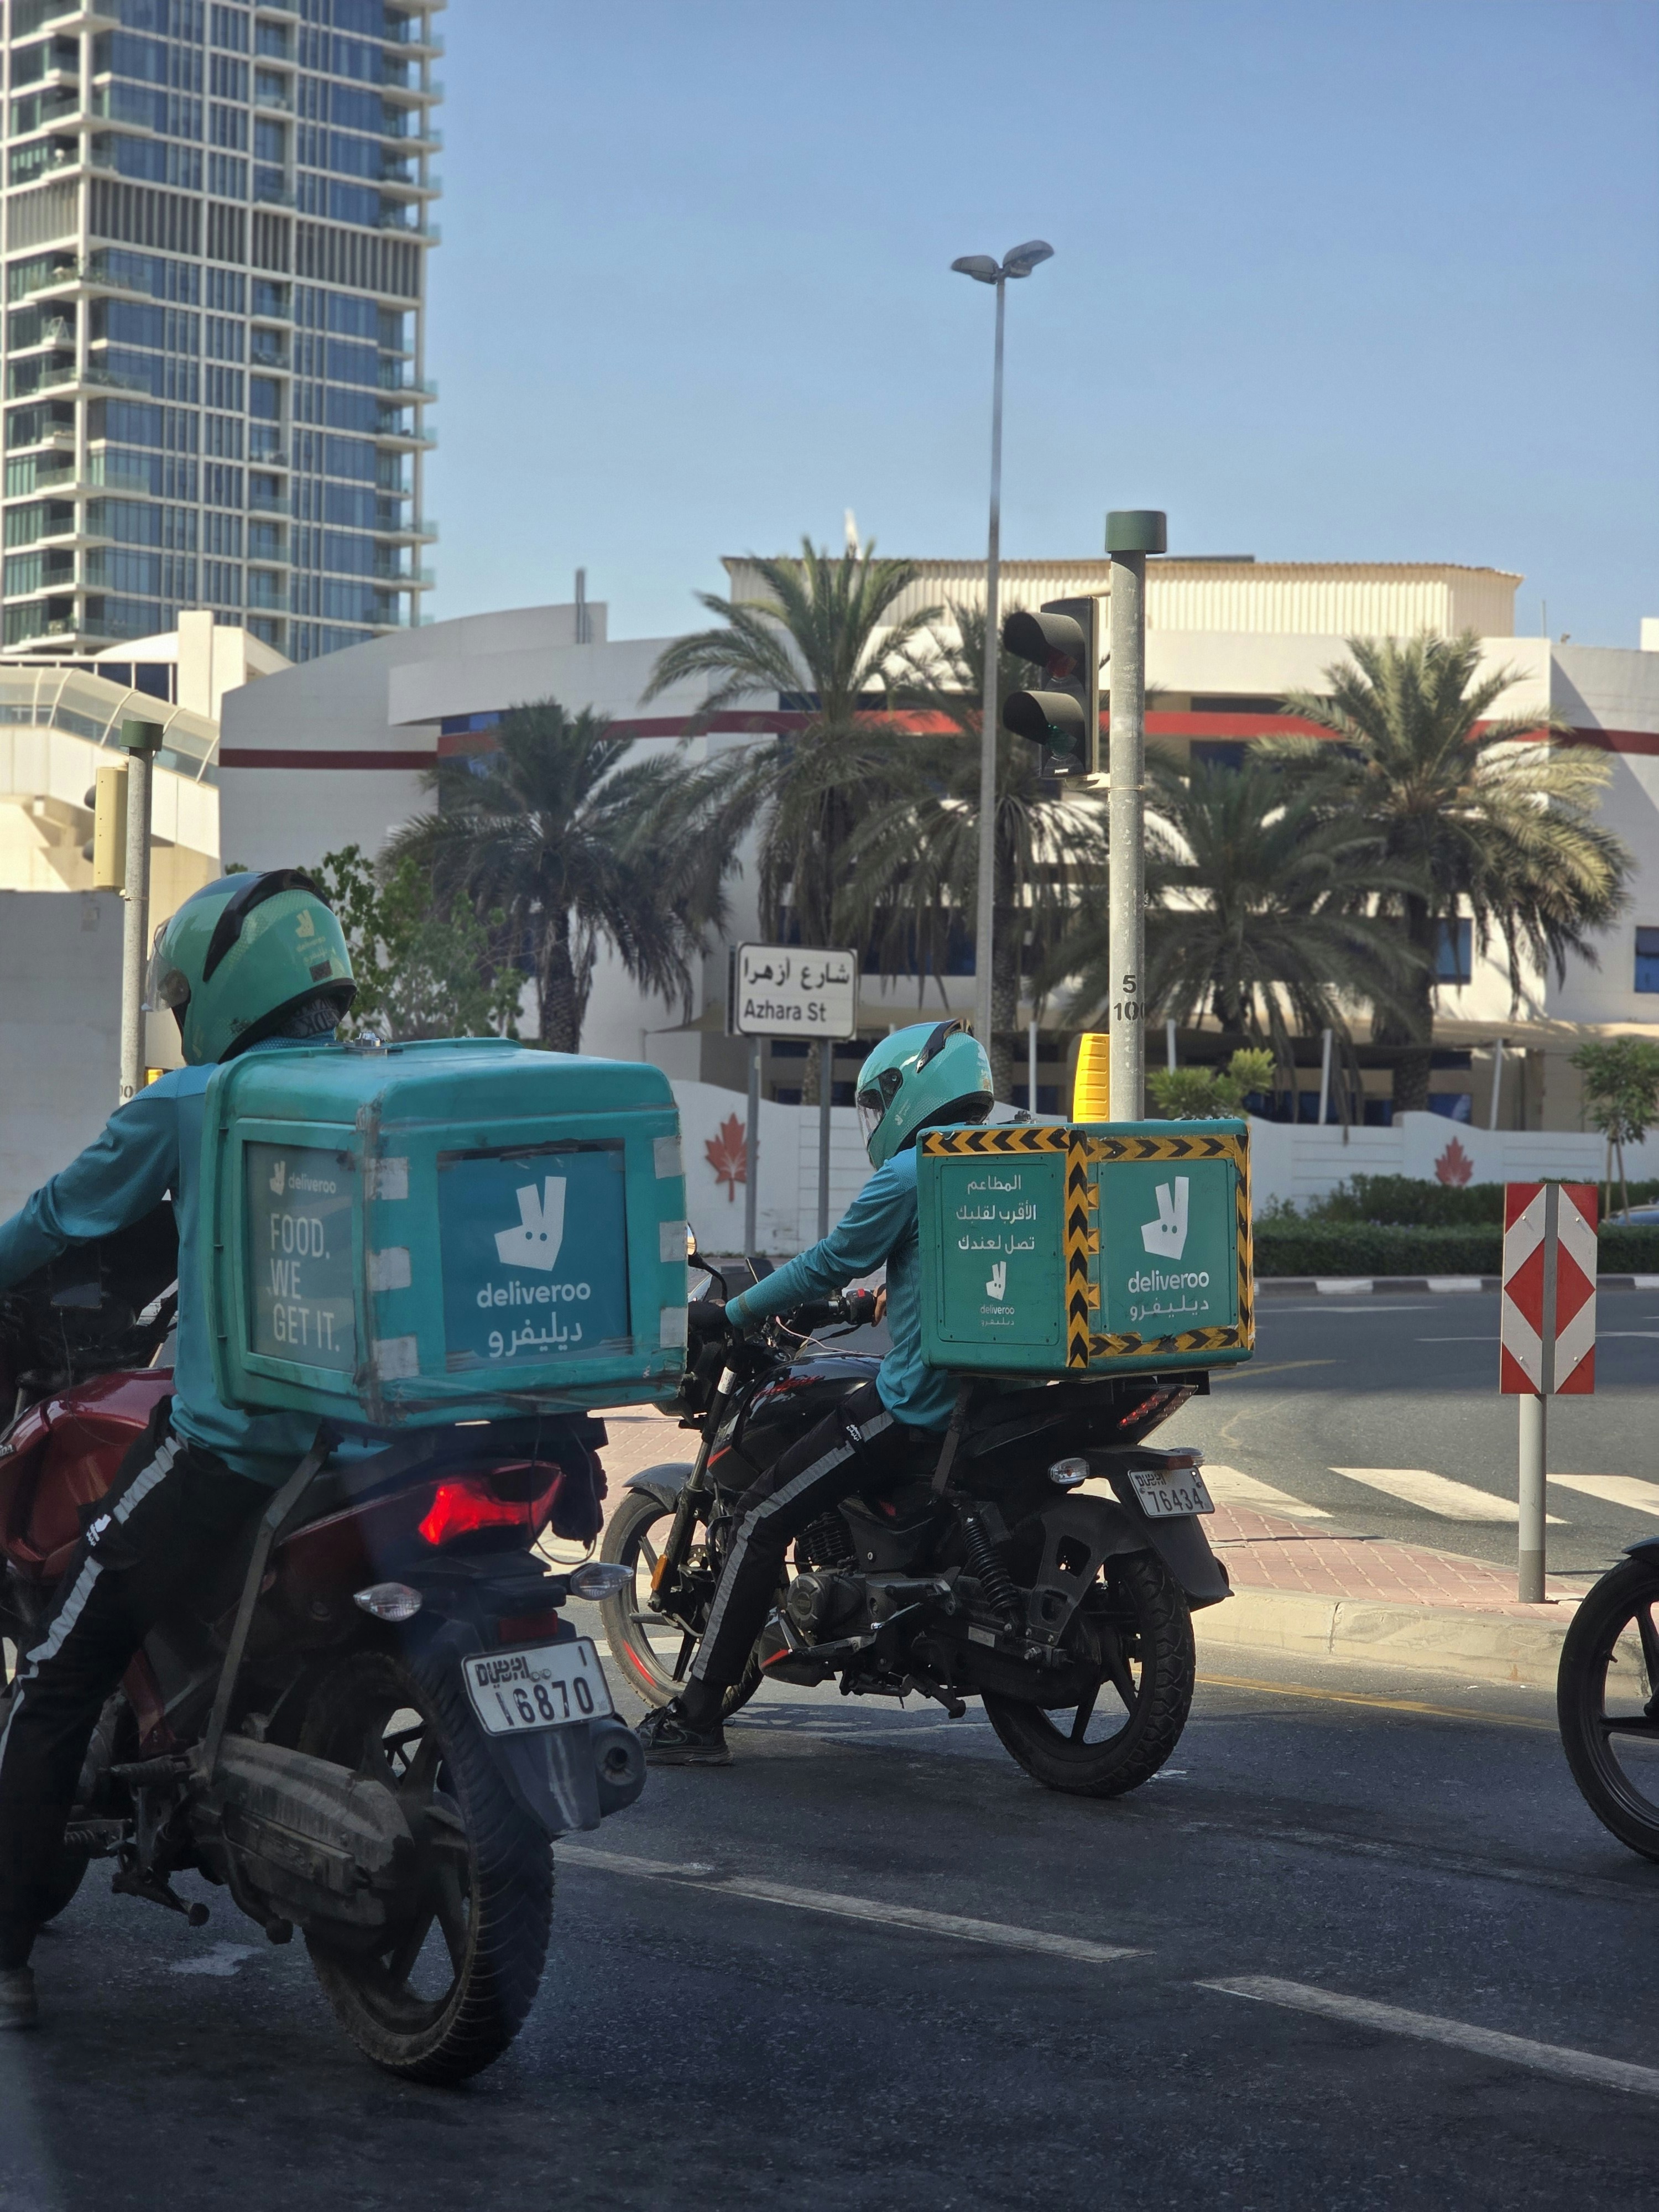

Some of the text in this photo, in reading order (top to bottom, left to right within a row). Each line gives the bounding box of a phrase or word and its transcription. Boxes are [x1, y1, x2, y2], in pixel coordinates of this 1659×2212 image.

[801, 962, 849, 990] شارع
[1122, 974, 1136, 994] 5
[744, 998, 826, 1022] Azhara St
[288, 1172, 337, 1194] deliveroo
[968, 1175, 1021, 1195] المطاعم
[956, 1200, 1036, 1224] الأقرب لقلبك
[270, 1213, 331, 1260] FOOD.
[958, 1234, 1035, 1255] تصل لعندك
[270, 1258, 301, 1300] WE
[1128, 1270, 1209, 1293] deliveroo
[477, 1280, 591, 1308] deliveroo
[980, 1304, 1015, 1315] deliveroo
[1130, 1295, 1209, 1322] ديليفرو
[273, 1302, 340, 1352] GET IT.
[488, 1311, 583, 1358] ديليفرو
[1147, 1488, 1204, 1512] 76434
[495, 1677, 594, 1726] 16870
